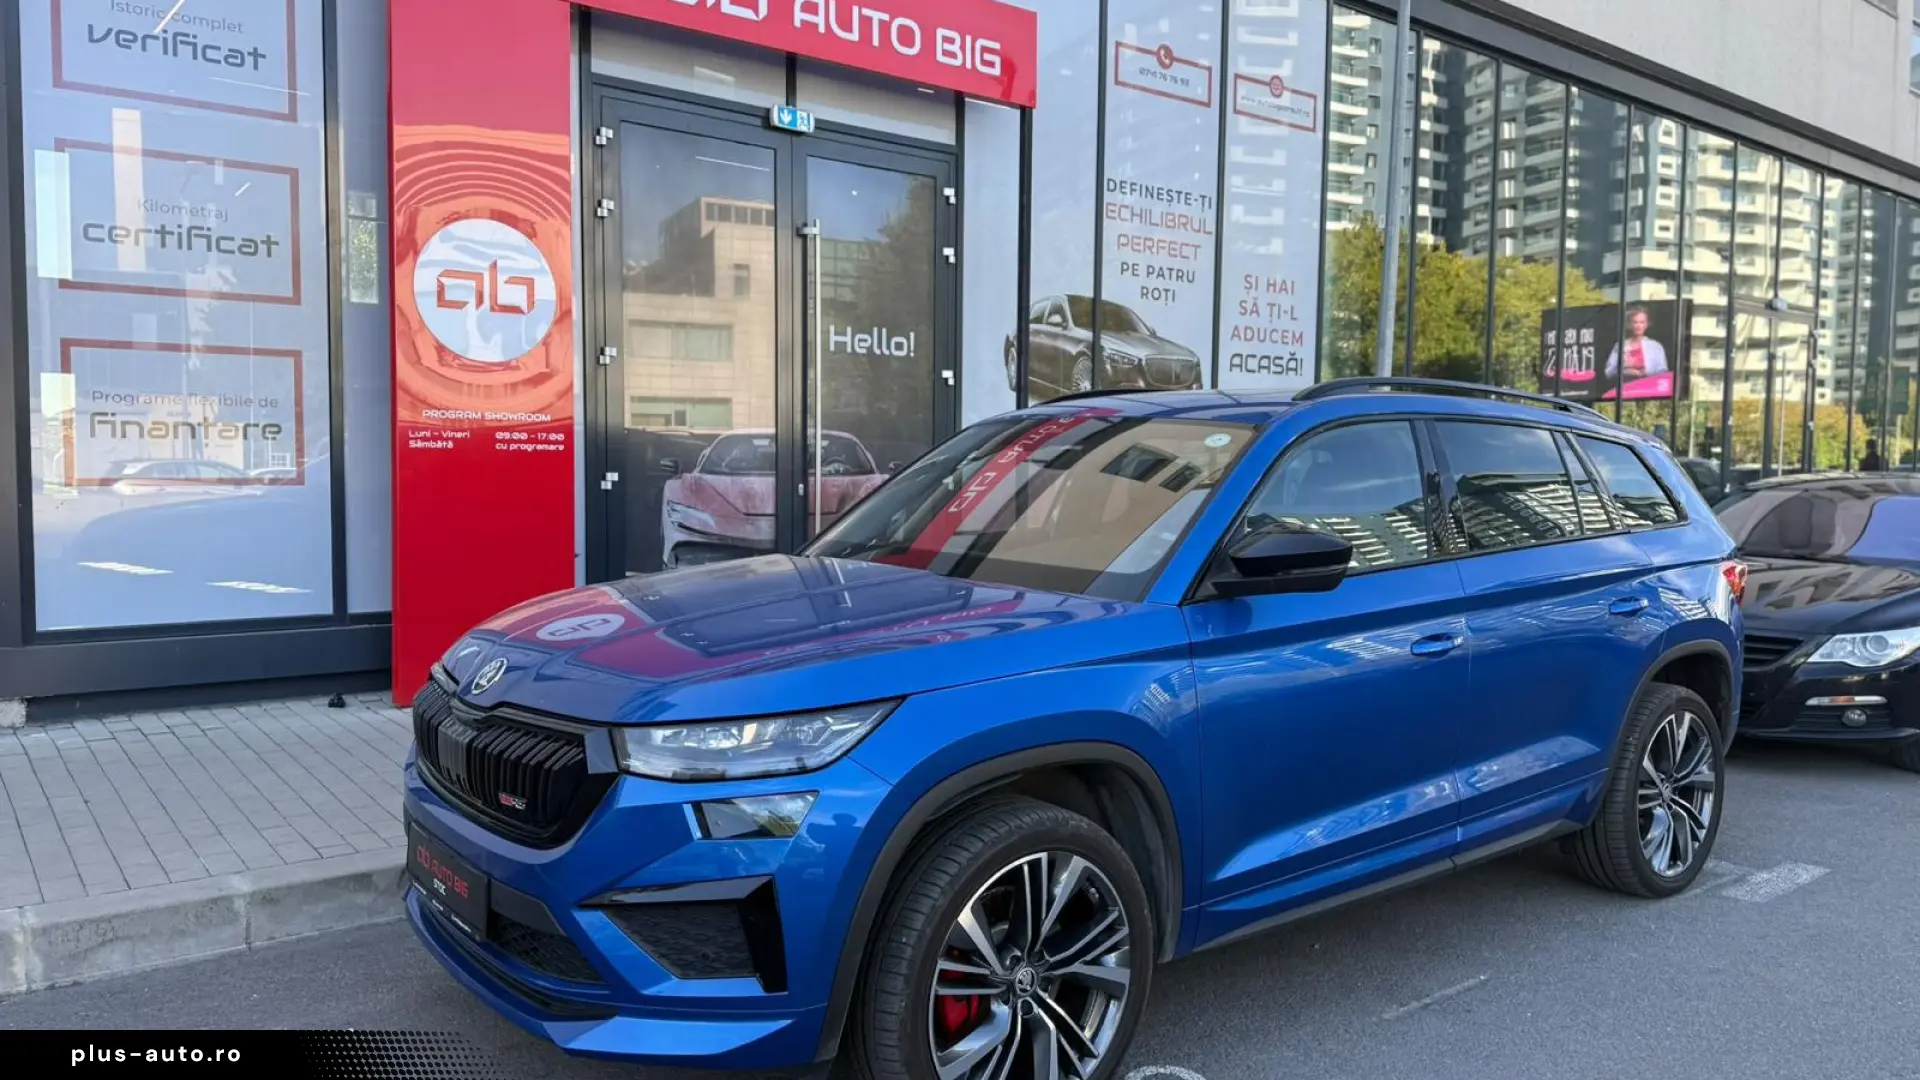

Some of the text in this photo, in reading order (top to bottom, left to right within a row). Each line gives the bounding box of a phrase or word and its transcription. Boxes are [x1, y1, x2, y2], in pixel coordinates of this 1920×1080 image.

[111, 0, 244, 34] Istoric complet
[88, 23, 267, 71] verificat
[793, 0, 921, 56] AUTO
[936, 27, 1001, 76] BIG
[1106, 178, 1212, 213] DEFINEȘTE-ȚI
[137, 199, 229, 222] Kilometraj
[1105, 202, 1213, 235] ECHILIBRUL
[82, 222, 280, 258] certificat
[1117, 234, 1202, 260] PERFECT
[1120, 262, 1196, 284] PE PATRU
[1243, 274, 1295, 296] ȘI HAI
[1141, 285, 1176, 306] ROȚI
[1238, 297, 1298, 323] SĂ ȚI-L
[829, 324, 915, 357] Hello!
[1230, 325, 1303, 346] ADUCEM
[1229, 351, 1303, 376] ACASĂ!
[92, 390, 279, 408] Programe flexibile de
[422, 409, 551, 422] PROGRAM SHOWROOM
[408, 430, 431, 439] Luni
[441, 430, 470, 439] Vineri
[495, 431, 529, 441] 09:00
[537, 432, 565, 441] 17:00
[509, 443, 565, 452] programare
